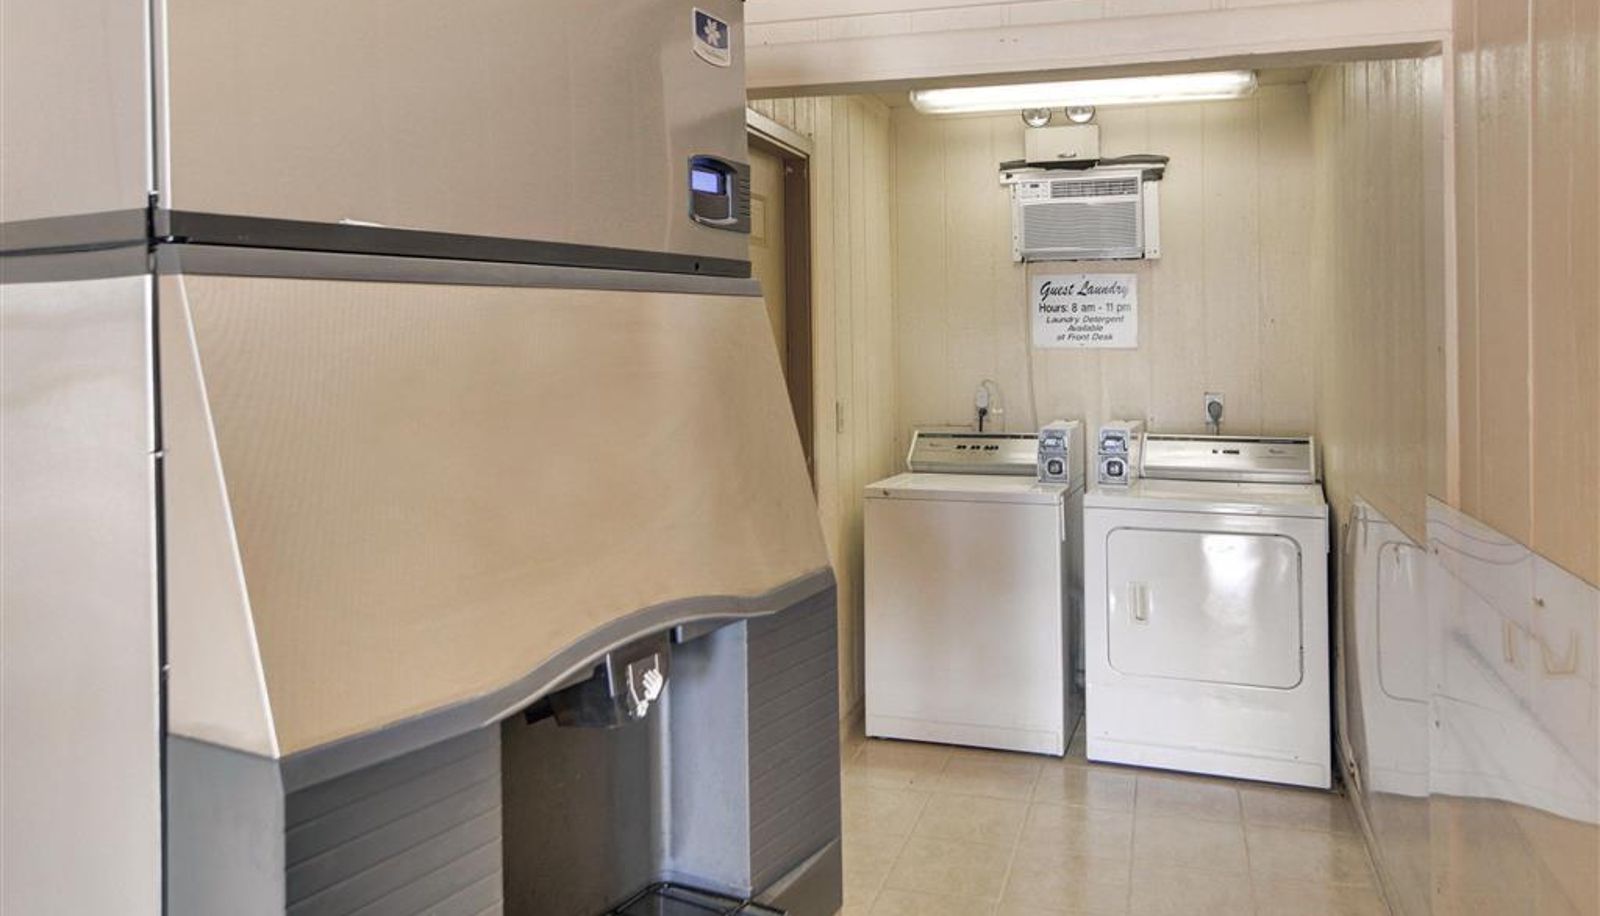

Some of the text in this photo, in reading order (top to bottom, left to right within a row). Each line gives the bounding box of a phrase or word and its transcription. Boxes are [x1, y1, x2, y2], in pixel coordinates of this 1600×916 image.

[1040, 281, 1129, 301] Guest Laundry
[1039, 303, 1068, 313] Hours:
[1071, 303, 1078, 313] 8
[1081, 304, 1096, 312] am
[1106, 303, 1113, 312] 11
[1116, 304, 1131, 313] pm
[1046, 315, 1125, 324] Laundry Detergent
[1067, 324, 1104, 332] Available
[1056, 333, 1113, 341] at Front Desk
